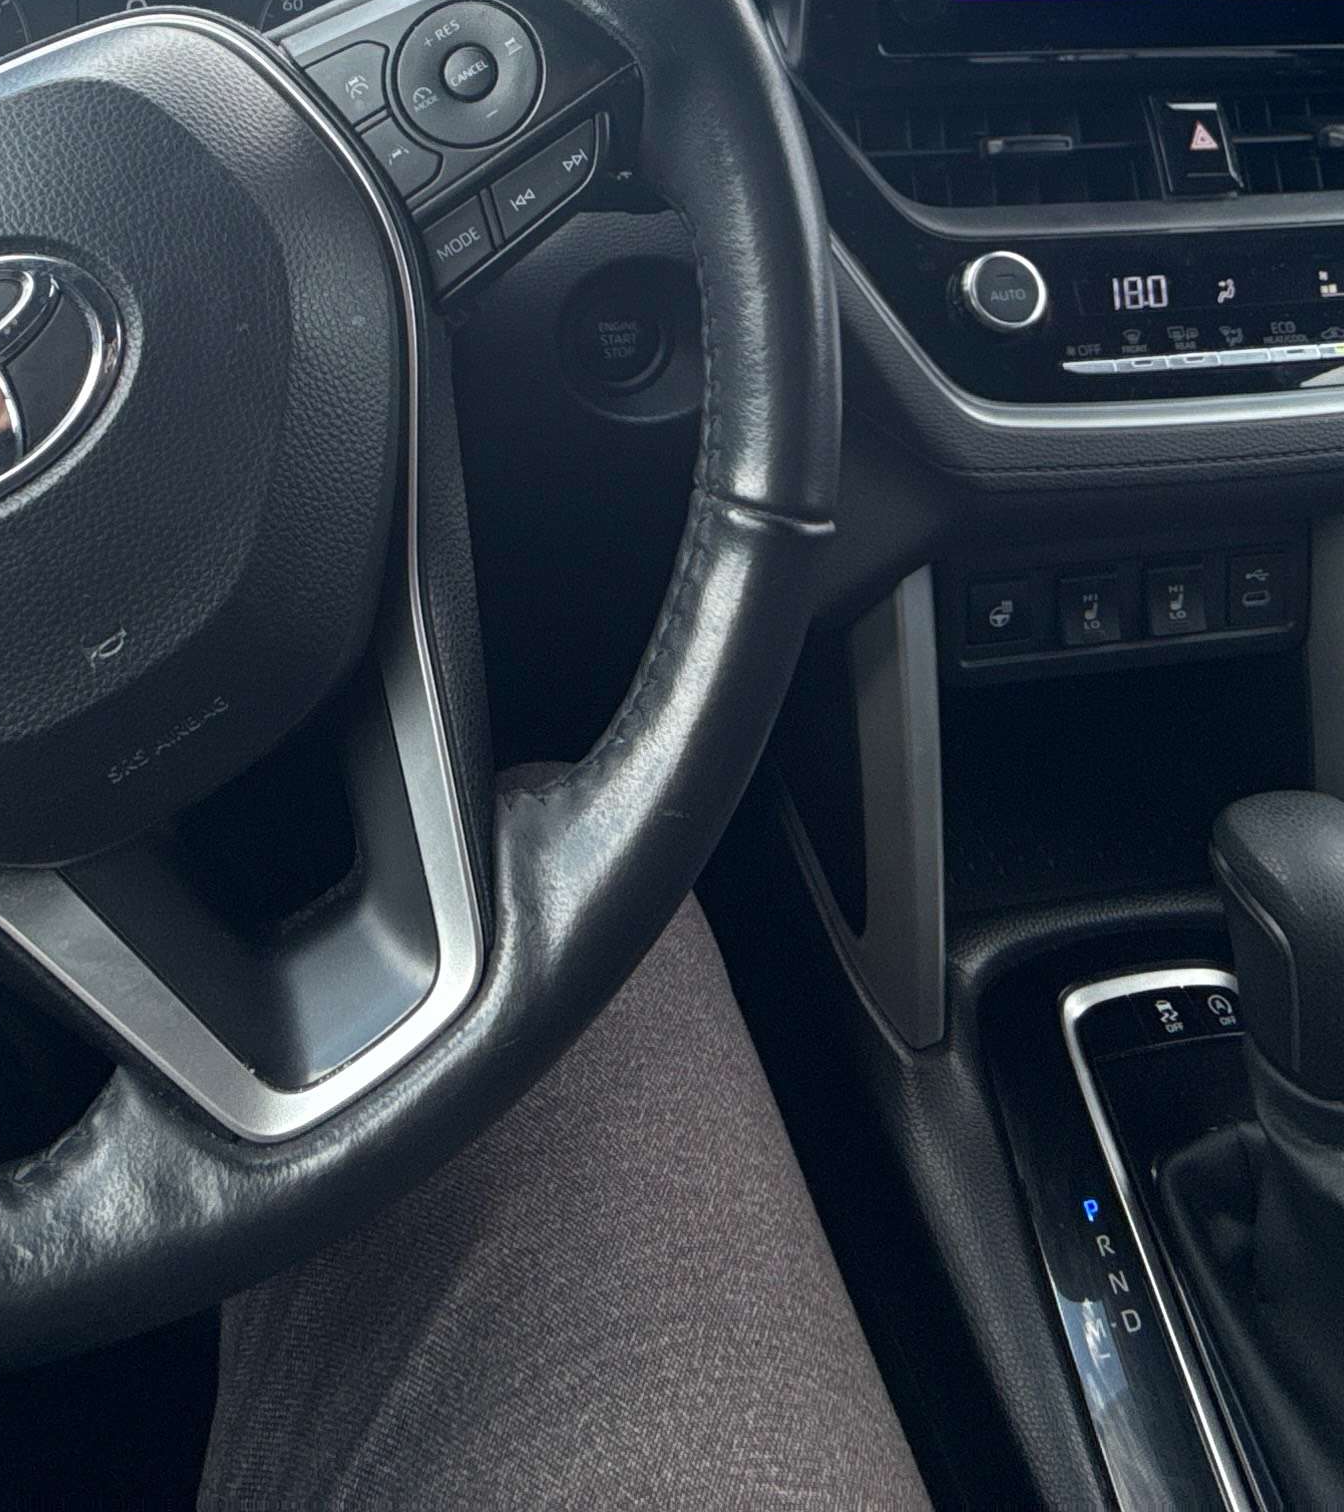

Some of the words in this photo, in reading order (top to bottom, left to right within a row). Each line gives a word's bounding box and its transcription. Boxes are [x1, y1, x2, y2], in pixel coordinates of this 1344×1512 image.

[434, 19, 462, 41] RES
[450, 59, 489, 88] CANCEL
[436, 225, 482, 263] MODE
[990, 287, 1027, 303] AUTO
[1111, 274, 1169, 311] 18.0
[1269, 320, 1297, 335] ECO
[1077, 344, 1102, 357] OFF
[1083, 619, 1101, 631] LO
[1169, 609, 1186, 619] LO
[1164, 1021, 1184, 1034] OFF
[1218, 1015, 1236, 1027] OFF
[1083, 1198, 1099, 1222] P
[1096, 1234, 1116, 1257] R
[1108, 1270, 1130, 1294] N
[1119, 1308, 1142, 1334] D
